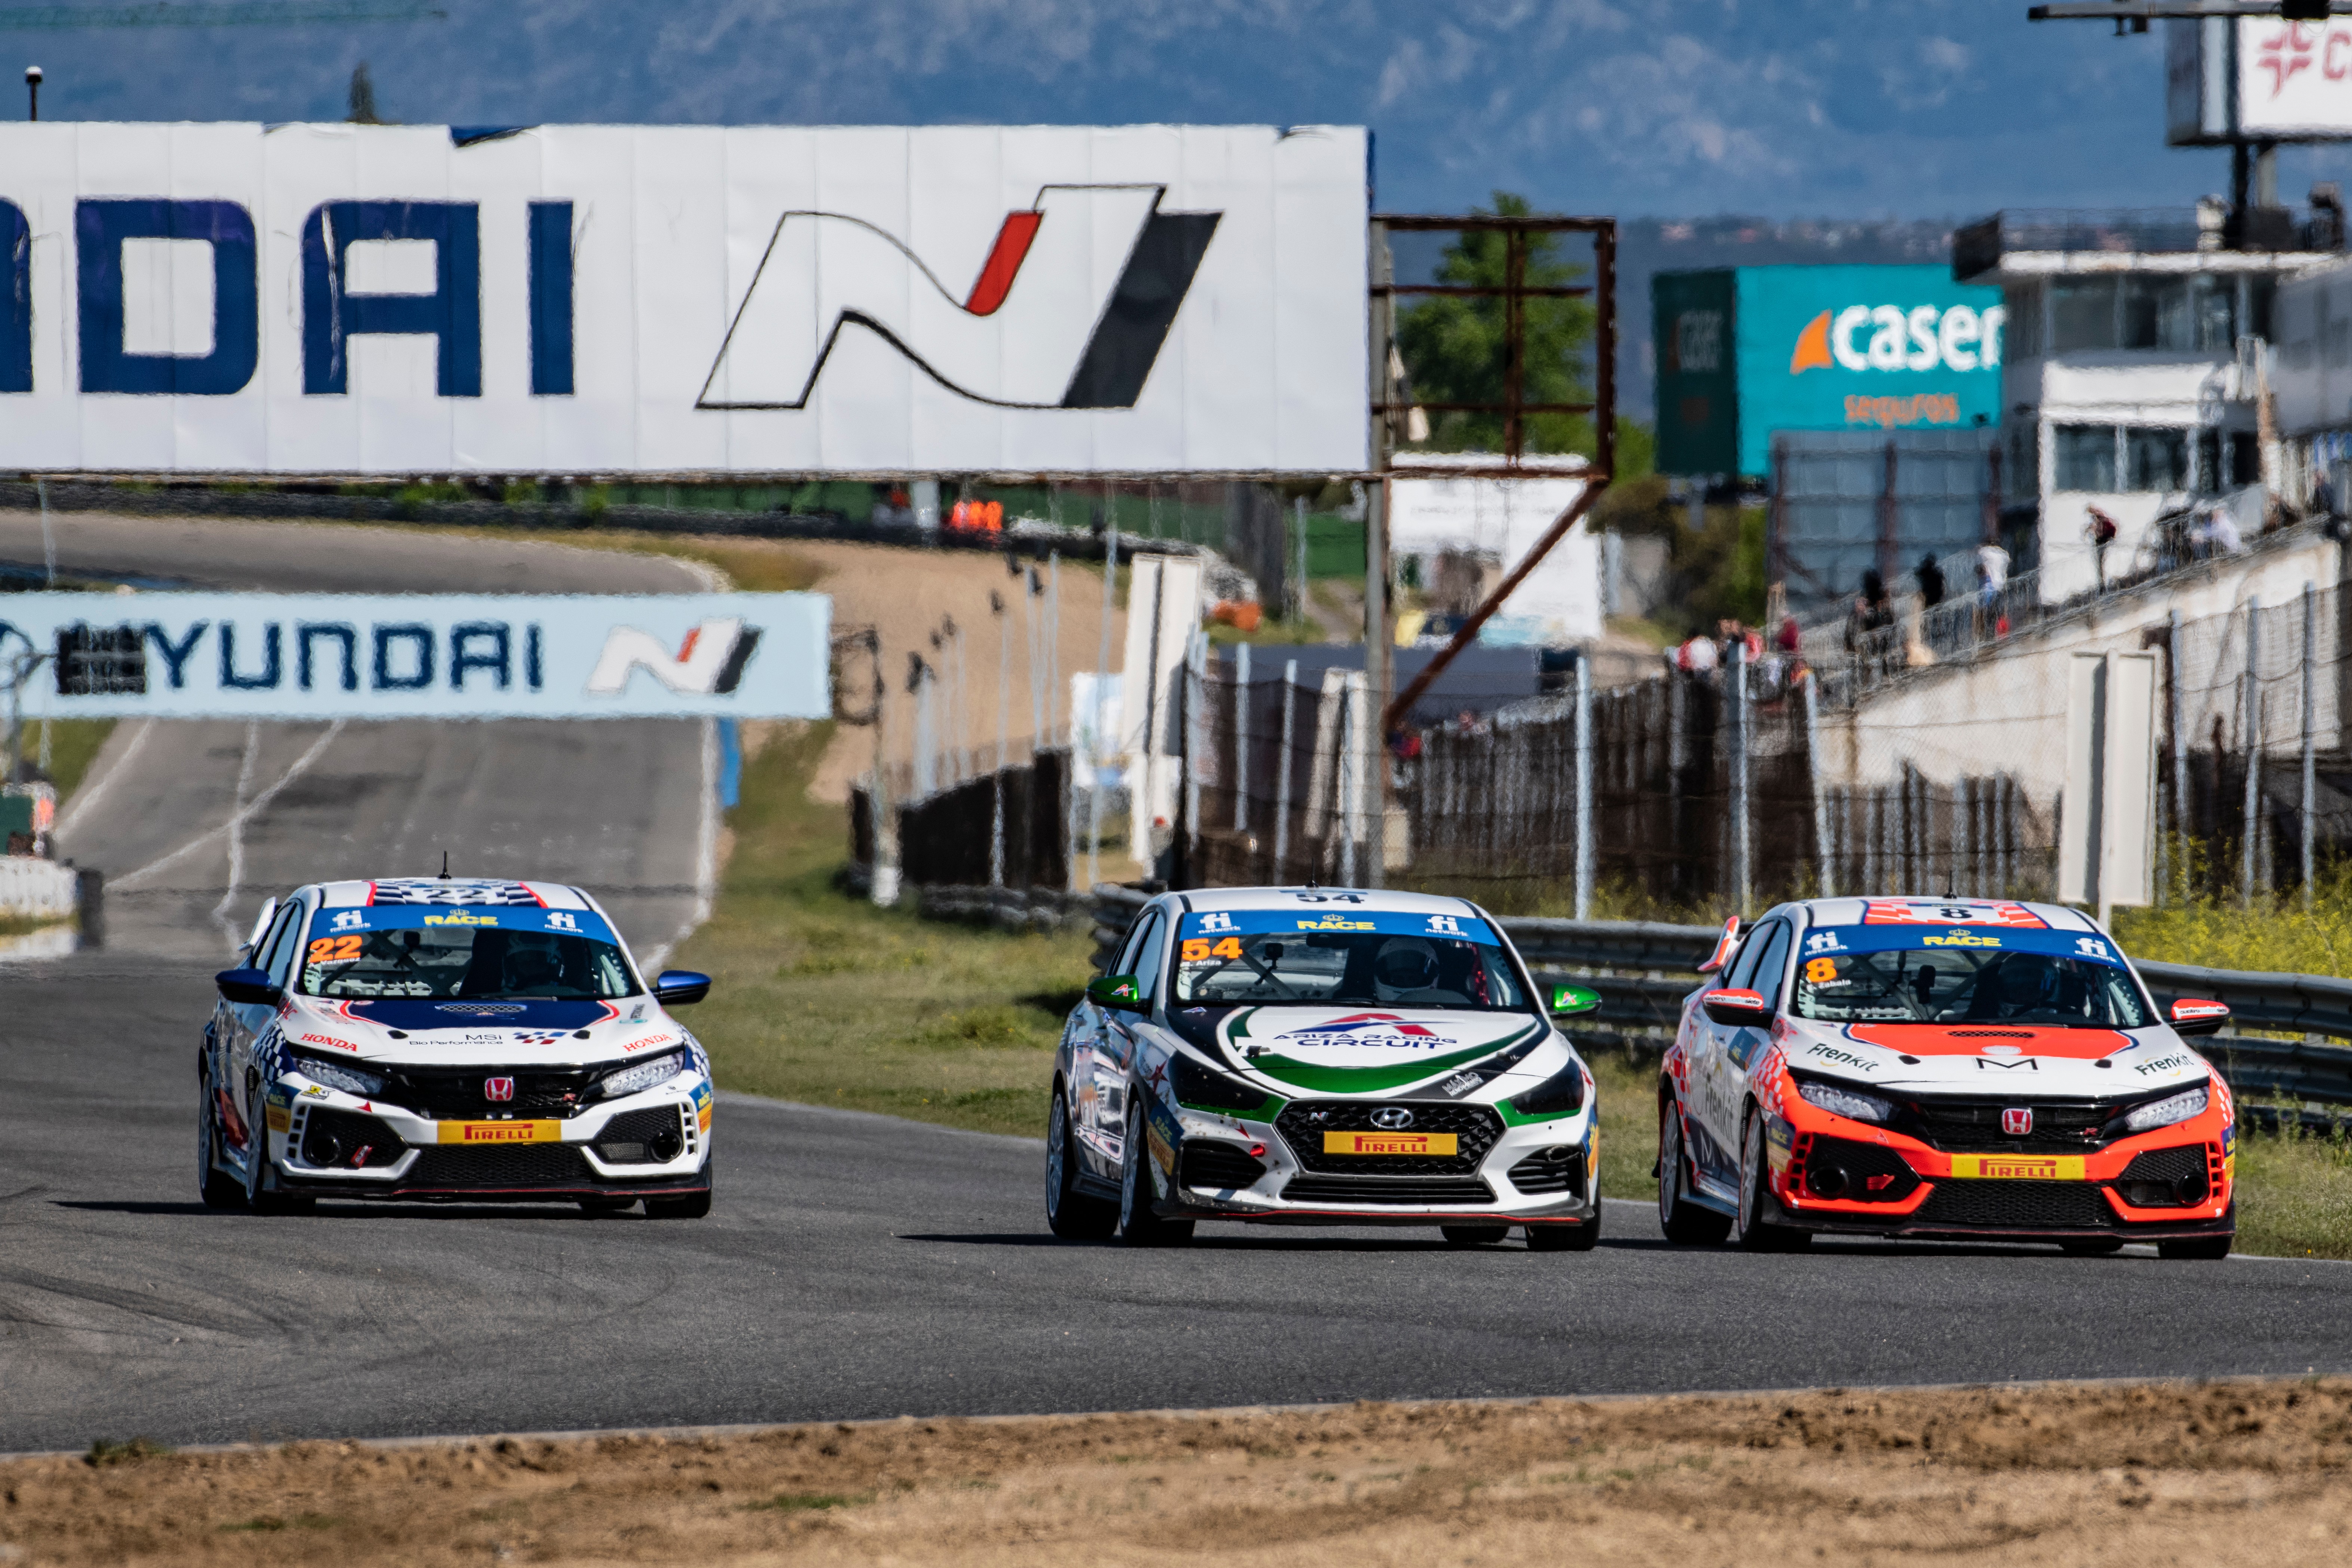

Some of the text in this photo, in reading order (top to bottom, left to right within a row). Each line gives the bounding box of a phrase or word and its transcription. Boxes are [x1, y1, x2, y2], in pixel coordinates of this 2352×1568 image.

[0, 195, 576, 397] DAI
[1832, 304, 2005, 372] caser
[1844, 392, 1960, 427] seguros
[73, 619, 544, 691] YUNDAI
[423, 888, 487, 899] 22
[1296, 893, 1365, 903] 54
[1940, 908, 1973, 918] 8
[424, 915, 499, 926] RACE
[1297, 921, 1376, 930] RACE
[330, 922, 371, 933] network
[545, 924, 584, 933] network
[1198, 925, 1241, 934] network
[1425, 928, 1469, 937] network
[1923, 937, 2002, 946] RACE
[310, 936, 363, 963] 22
[1182, 937, 1243, 960] 54
[1804, 944, 1848, 956] network
[2075, 950, 2117, 963] network
[1806, 958, 1837, 982] 8
[1818, 979, 1851, 989] Zabala
[300, 1033, 357, 1052] HONDA
[622, 1034, 672, 1051] HONDA
[1297, 1039, 1446, 1049] CIRCUIT
[1364, 1034, 1457, 1044] RACING
[1807, 1043, 1880, 1072] Frenkit
[2134, 1053, 2194, 1076] Frenkit
[464, 1124, 533, 1139] PIRELLI
[1354, 1136, 1428, 1152] PIRELLI
[1979, 1159, 2057, 1178] PIRELLI
